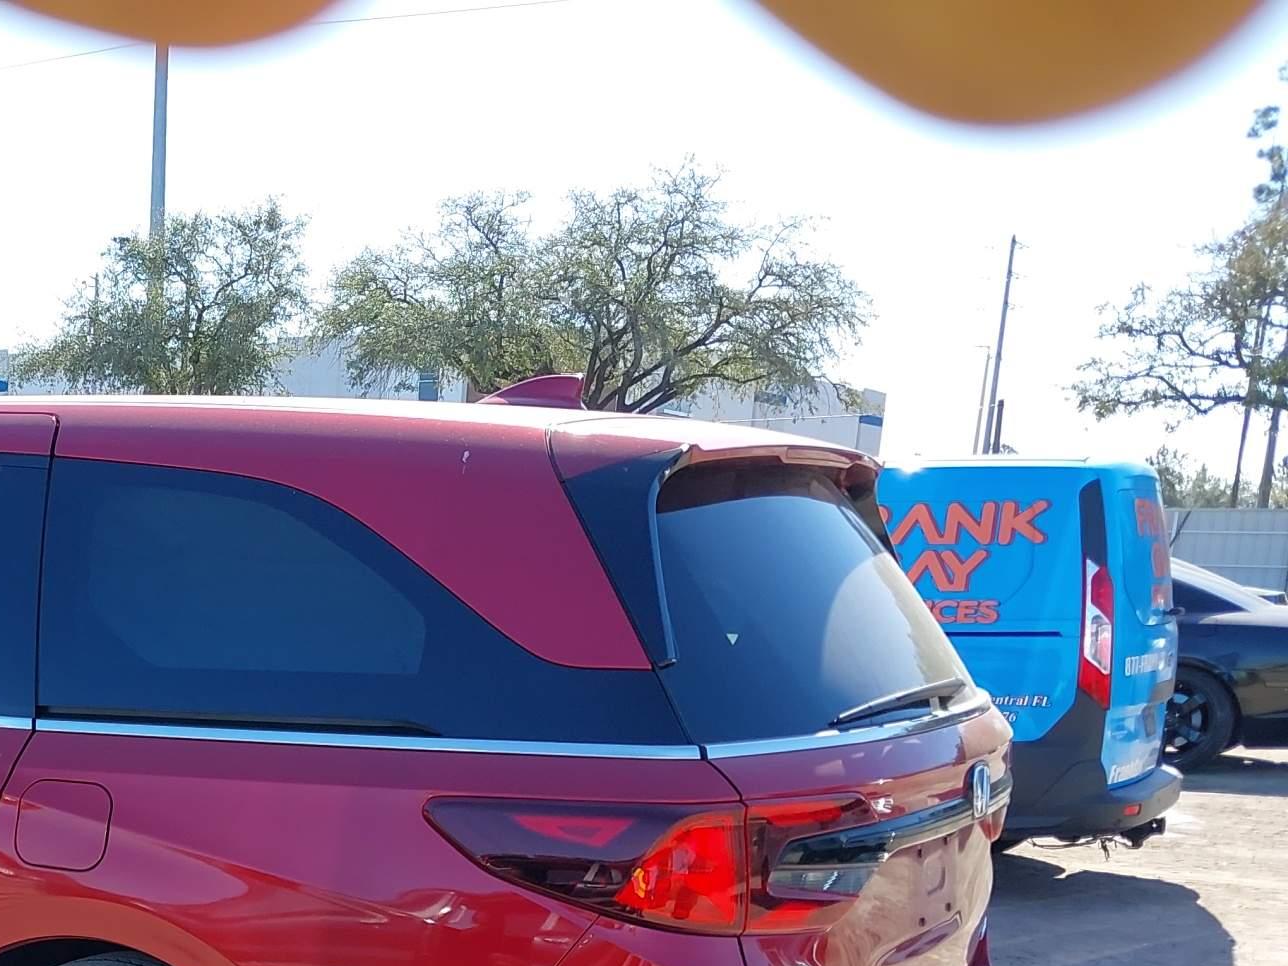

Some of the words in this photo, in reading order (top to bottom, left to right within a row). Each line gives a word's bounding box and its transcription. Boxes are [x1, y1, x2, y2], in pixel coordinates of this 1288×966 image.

[904, 549, 989, 592] AY
[927, 600, 1000, 624] CES
[1002, 711, 1017, 722] 76
